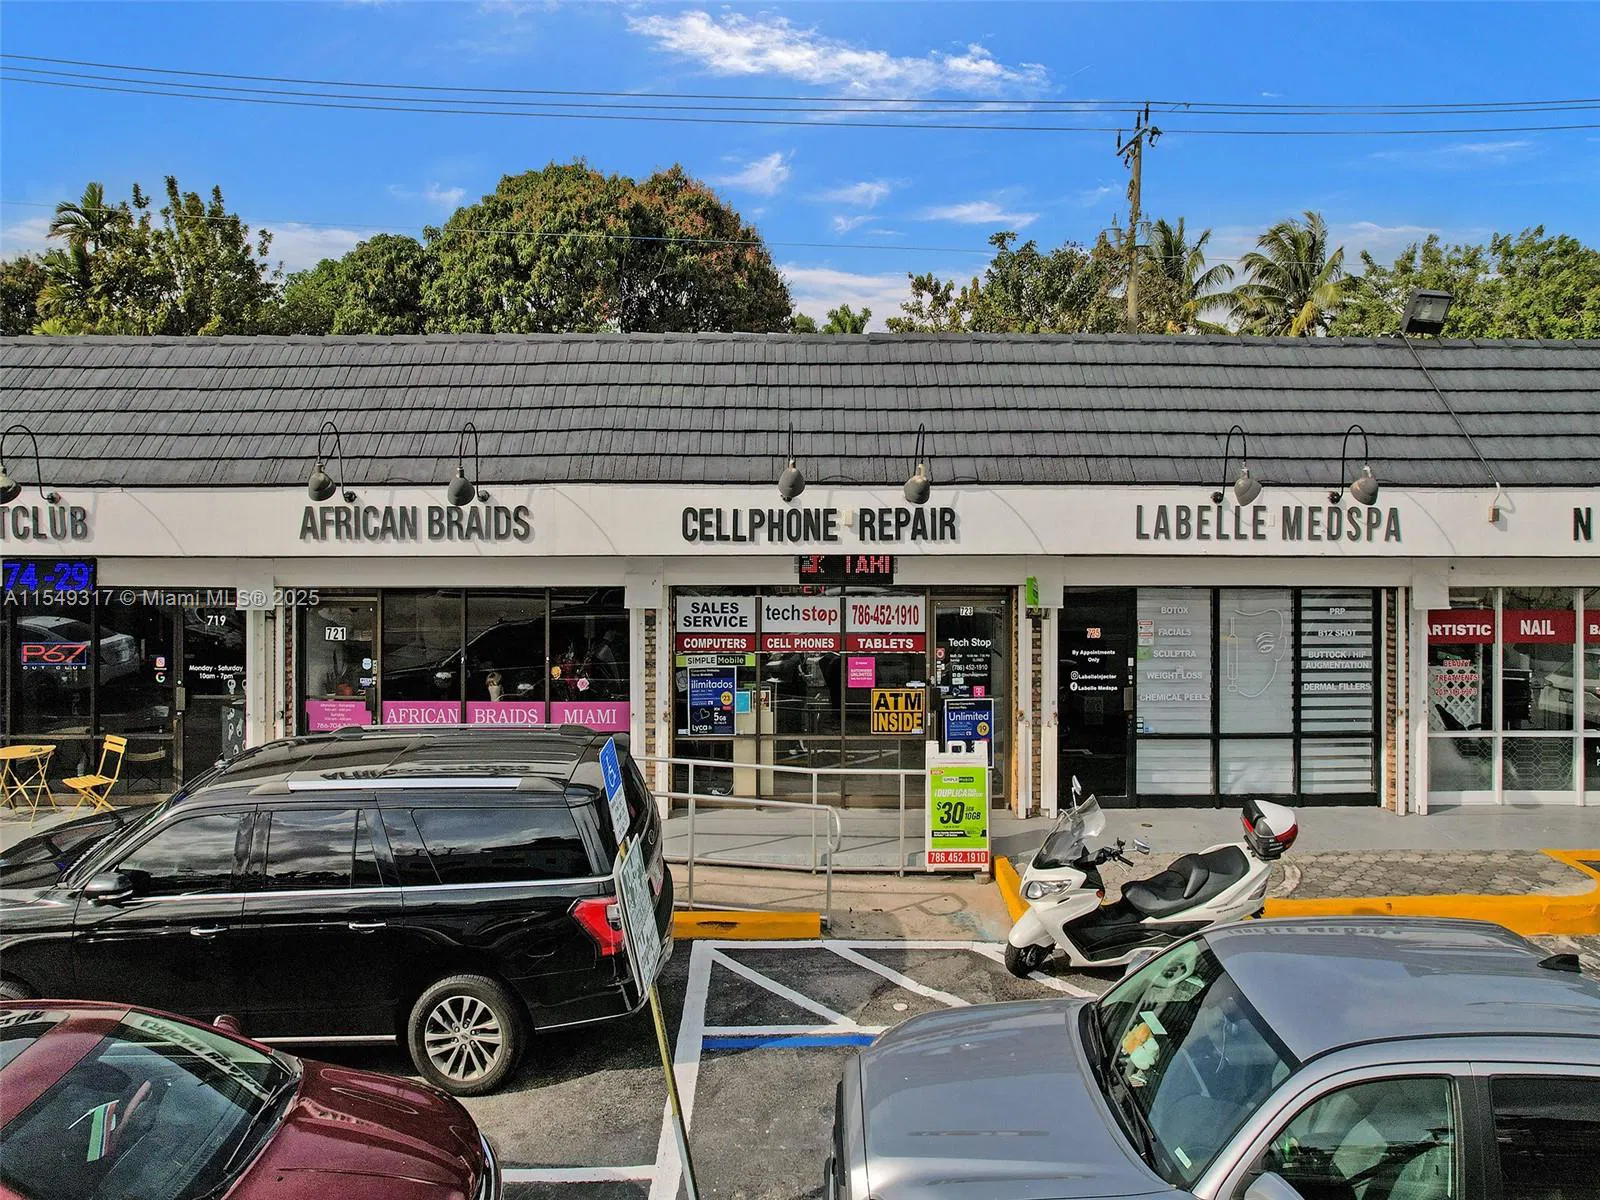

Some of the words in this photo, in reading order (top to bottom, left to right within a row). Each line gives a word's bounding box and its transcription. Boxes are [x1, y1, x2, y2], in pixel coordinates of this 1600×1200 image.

[0, 506, 88, 540] TCLUB
[299, 506, 417, 540] AFRICAN
[428, 506, 530, 540] BRAIDS
[682, 507, 838, 542] CELLPHONE
[859, 507, 956, 541] REPAIR
[1136, 505, 1267, 540] LABELLE
[1281, 506, 1402, 542] MEDSPA
[1573, 507, 1592, 541] N
[2, 563, 94, 591] 74-29
[691, 602, 739, 614] SALES
[1161, 606, 1189, 614] BOTOX
[207, 615, 226, 626] 719
[852, 605, 919, 626] 786-452-1910
[683, 615, 748, 628] SERVICE
[1520, 619, 1555, 635] NAIL
[326, 627, 345, 640] 721
[1158, 628, 1192, 636] FACIALS
[1335, 629, 1357, 637] SHOT
[1589, 624, 1600, 635] B
[683, 638, 747, 649] COMPUTERS
[767, 638, 791, 649] CELL
[794, 638, 834, 649] PHONES
[858, 638, 914, 649] TABLETS
[948, 638, 969, 647] Tech
[971, 638, 992, 648] Stop
[23, 644, 88, 663] P67
[1153, 650, 1197, 658] SCULPTRA
[1308, 650, 1346, 658] BUTTOCK
[1305, 661, 1369, 669] AUGMENTATION
[1147, 672, 1179, 680] WEIGHT
[1181, 672, 1202, 680] LOSS
[691, 680, 733, 689] ilimitados
[1303, 683, 1337, 691] DERMAL
[875, 693, 921, 711] ATM
[1140, 693, 1182, 701] CHEMICAL
[1184, 693, 1210, 701] PEELS
[387, 707, 460, 723] AFRICAN
[475, 708, 538, 724] BRAIDS
[564, 709, 617, 724] MIAMI
[949, 712, 989, 720] Unlimited
[874, 713, 922, 732] INSIDE
[691, 724, 708, 733] Lyca
[936, 801, 965, 825] $30
[965, 812, 981, 820] 10GB
[930, 852, 986, 863] 786.452.1910
